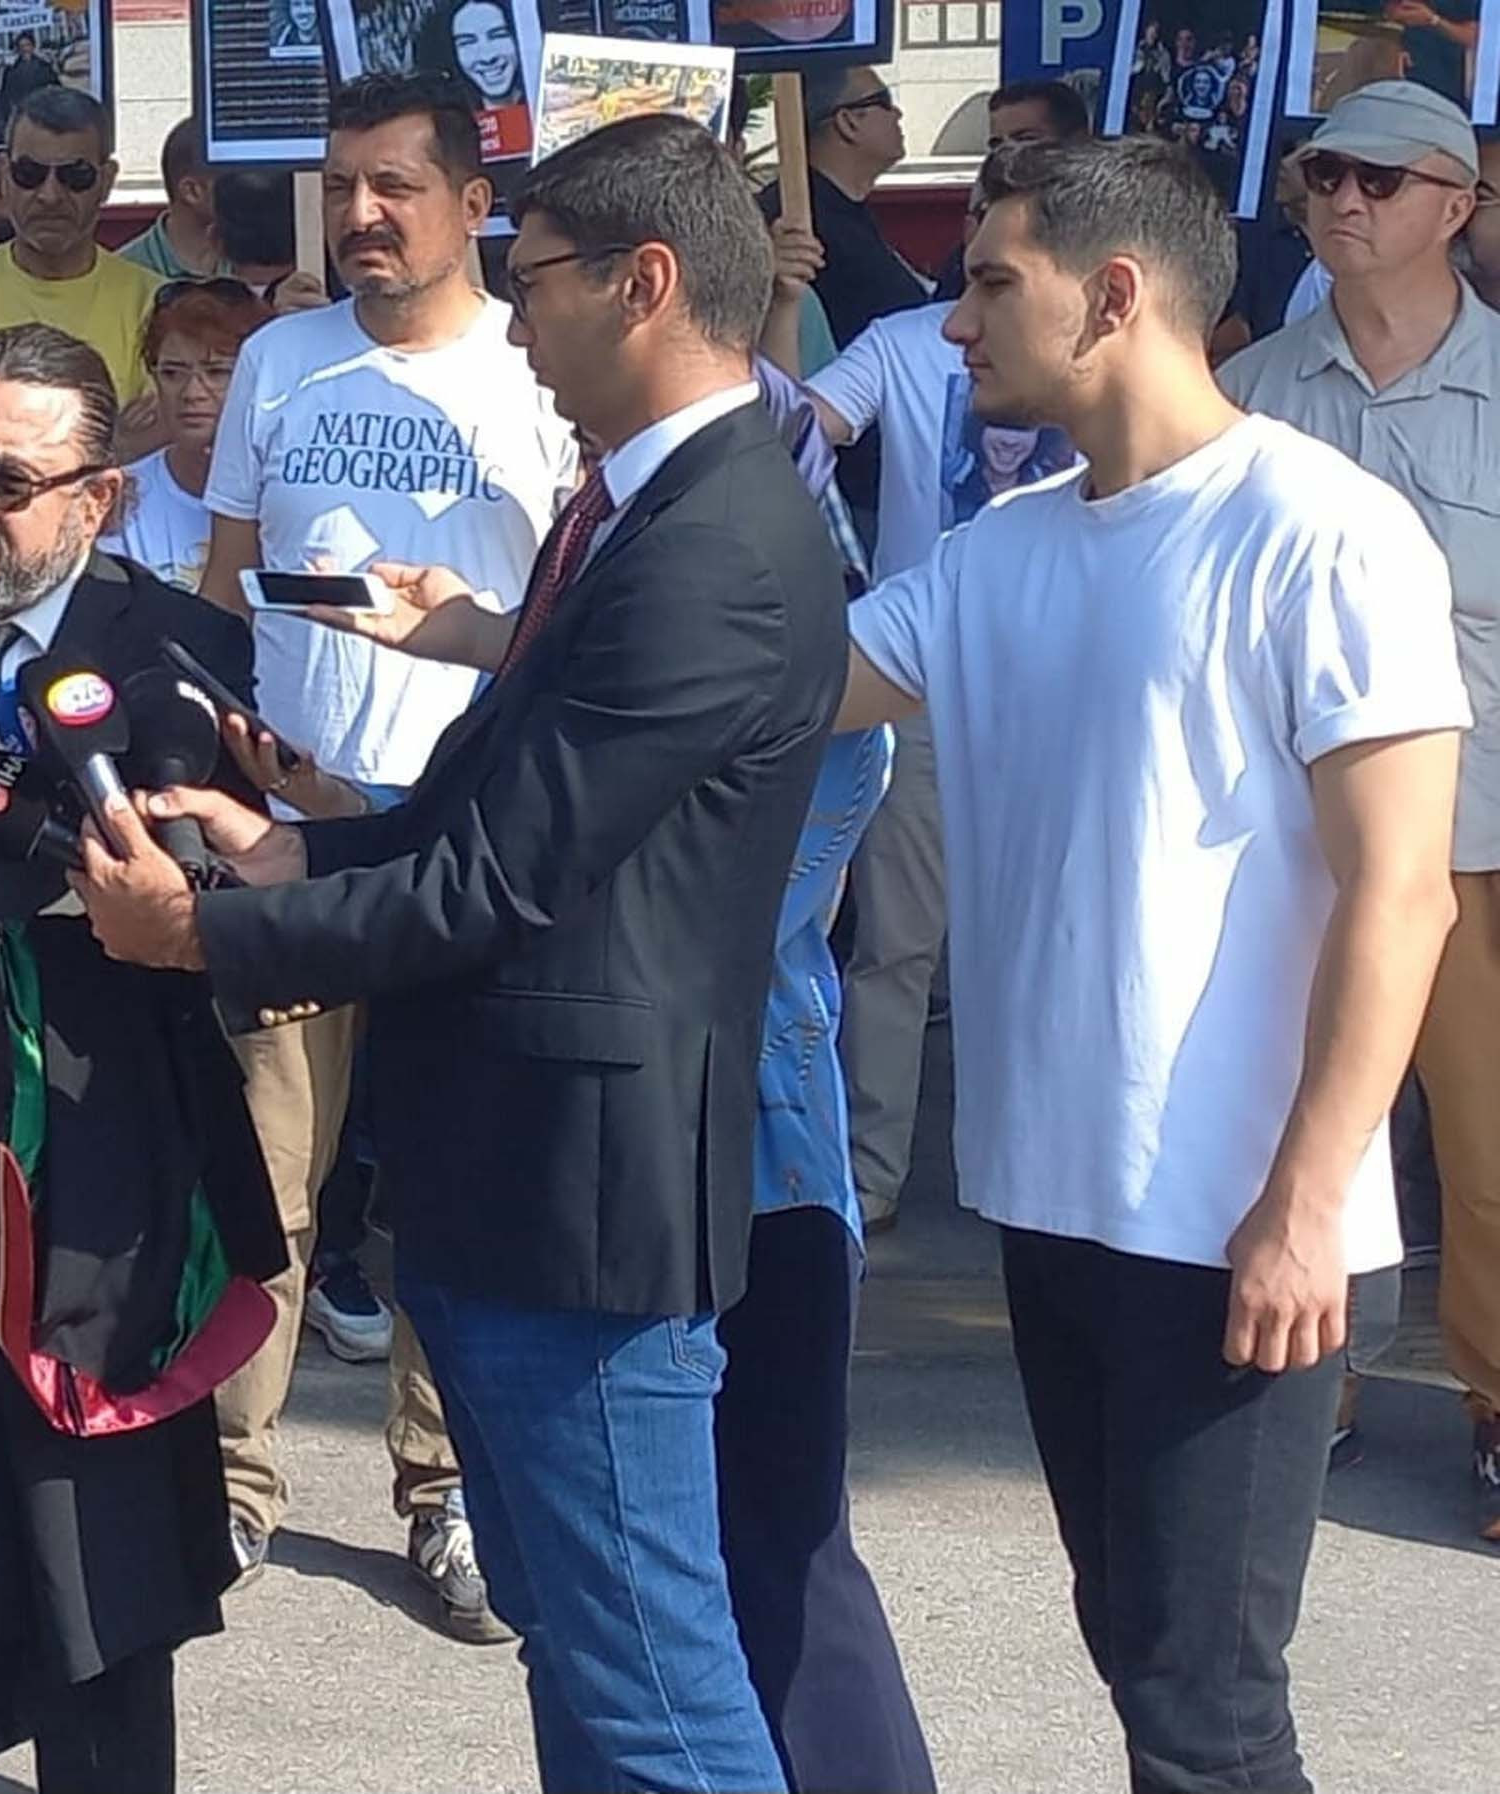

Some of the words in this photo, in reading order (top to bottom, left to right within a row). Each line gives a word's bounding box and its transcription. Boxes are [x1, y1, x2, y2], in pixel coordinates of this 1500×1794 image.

[1041, 0, 1103, 65] P
[311, 413, 485, 459] NATIONAL
[283, 448, 504, 502] GEOGRAPHIC
